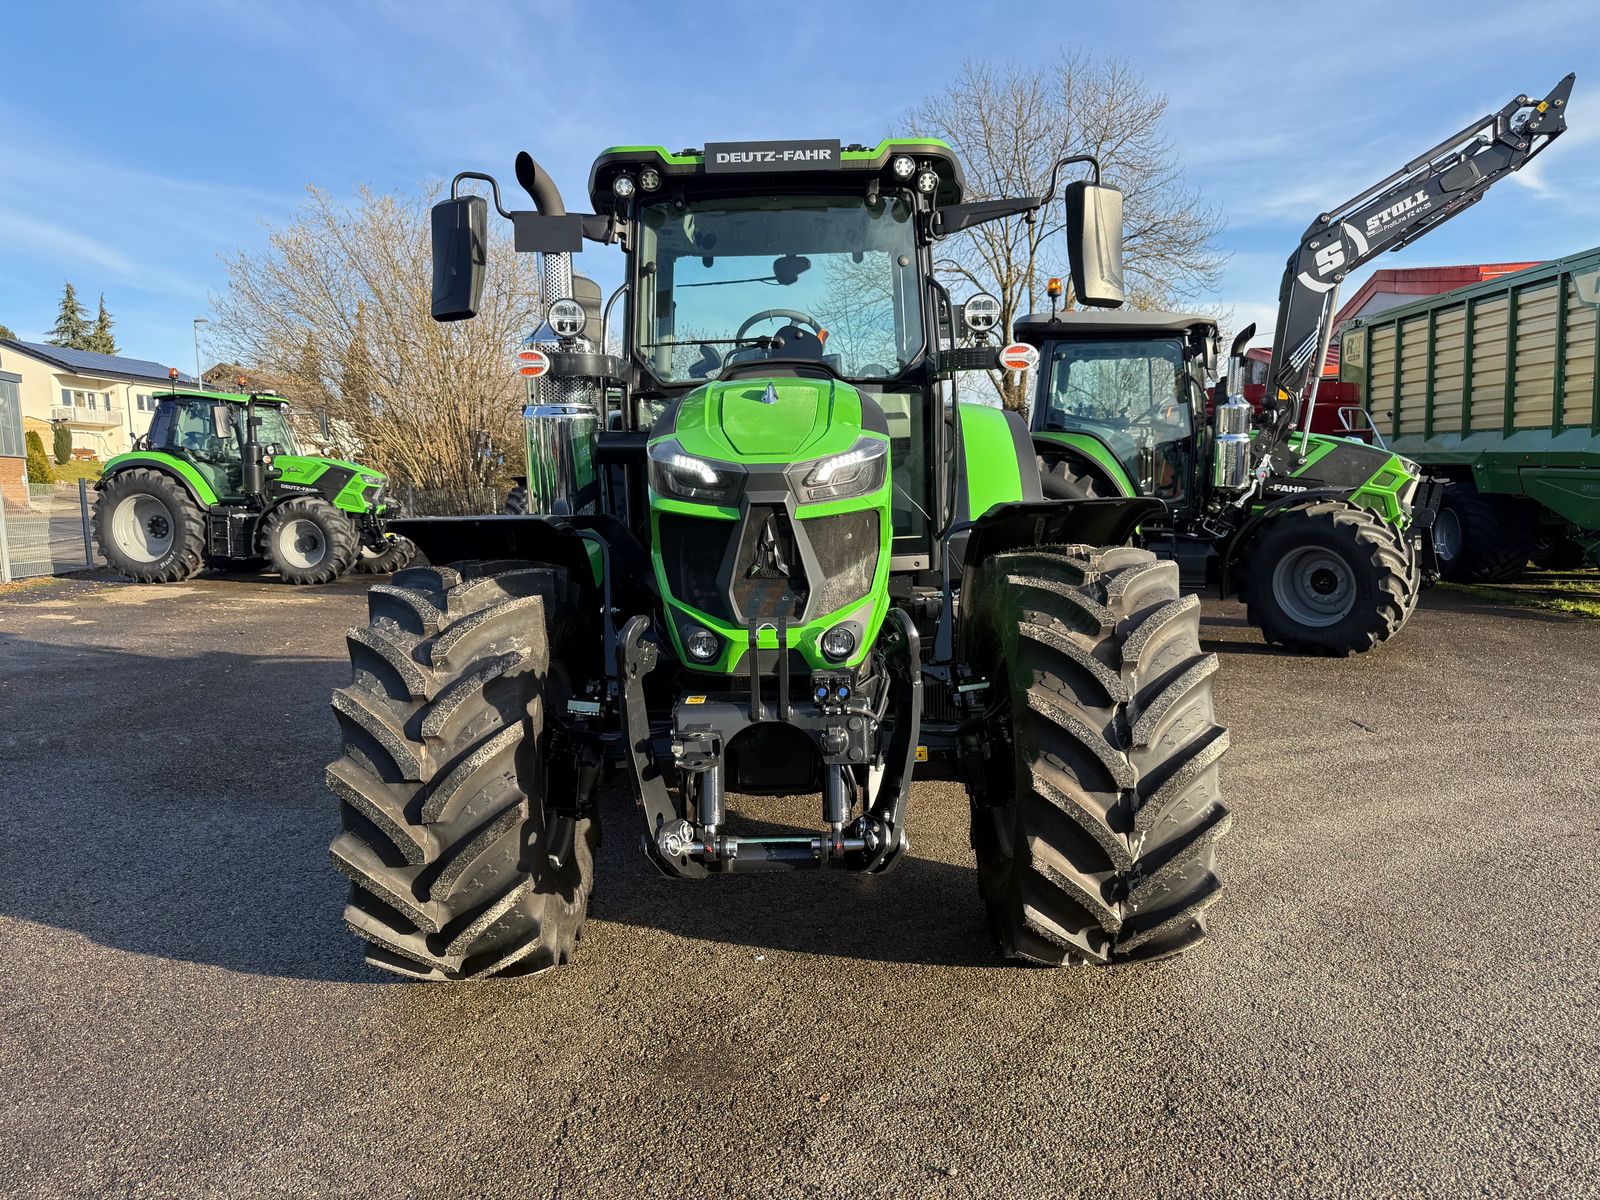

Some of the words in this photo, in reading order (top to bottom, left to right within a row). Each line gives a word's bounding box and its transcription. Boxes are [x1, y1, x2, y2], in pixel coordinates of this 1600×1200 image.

[716, 149, 832, 164] DEUTZ-FAHR
[1366, 190, 1429, 231] STOLL
[1265, 484, 1308, 493] -FAHR
